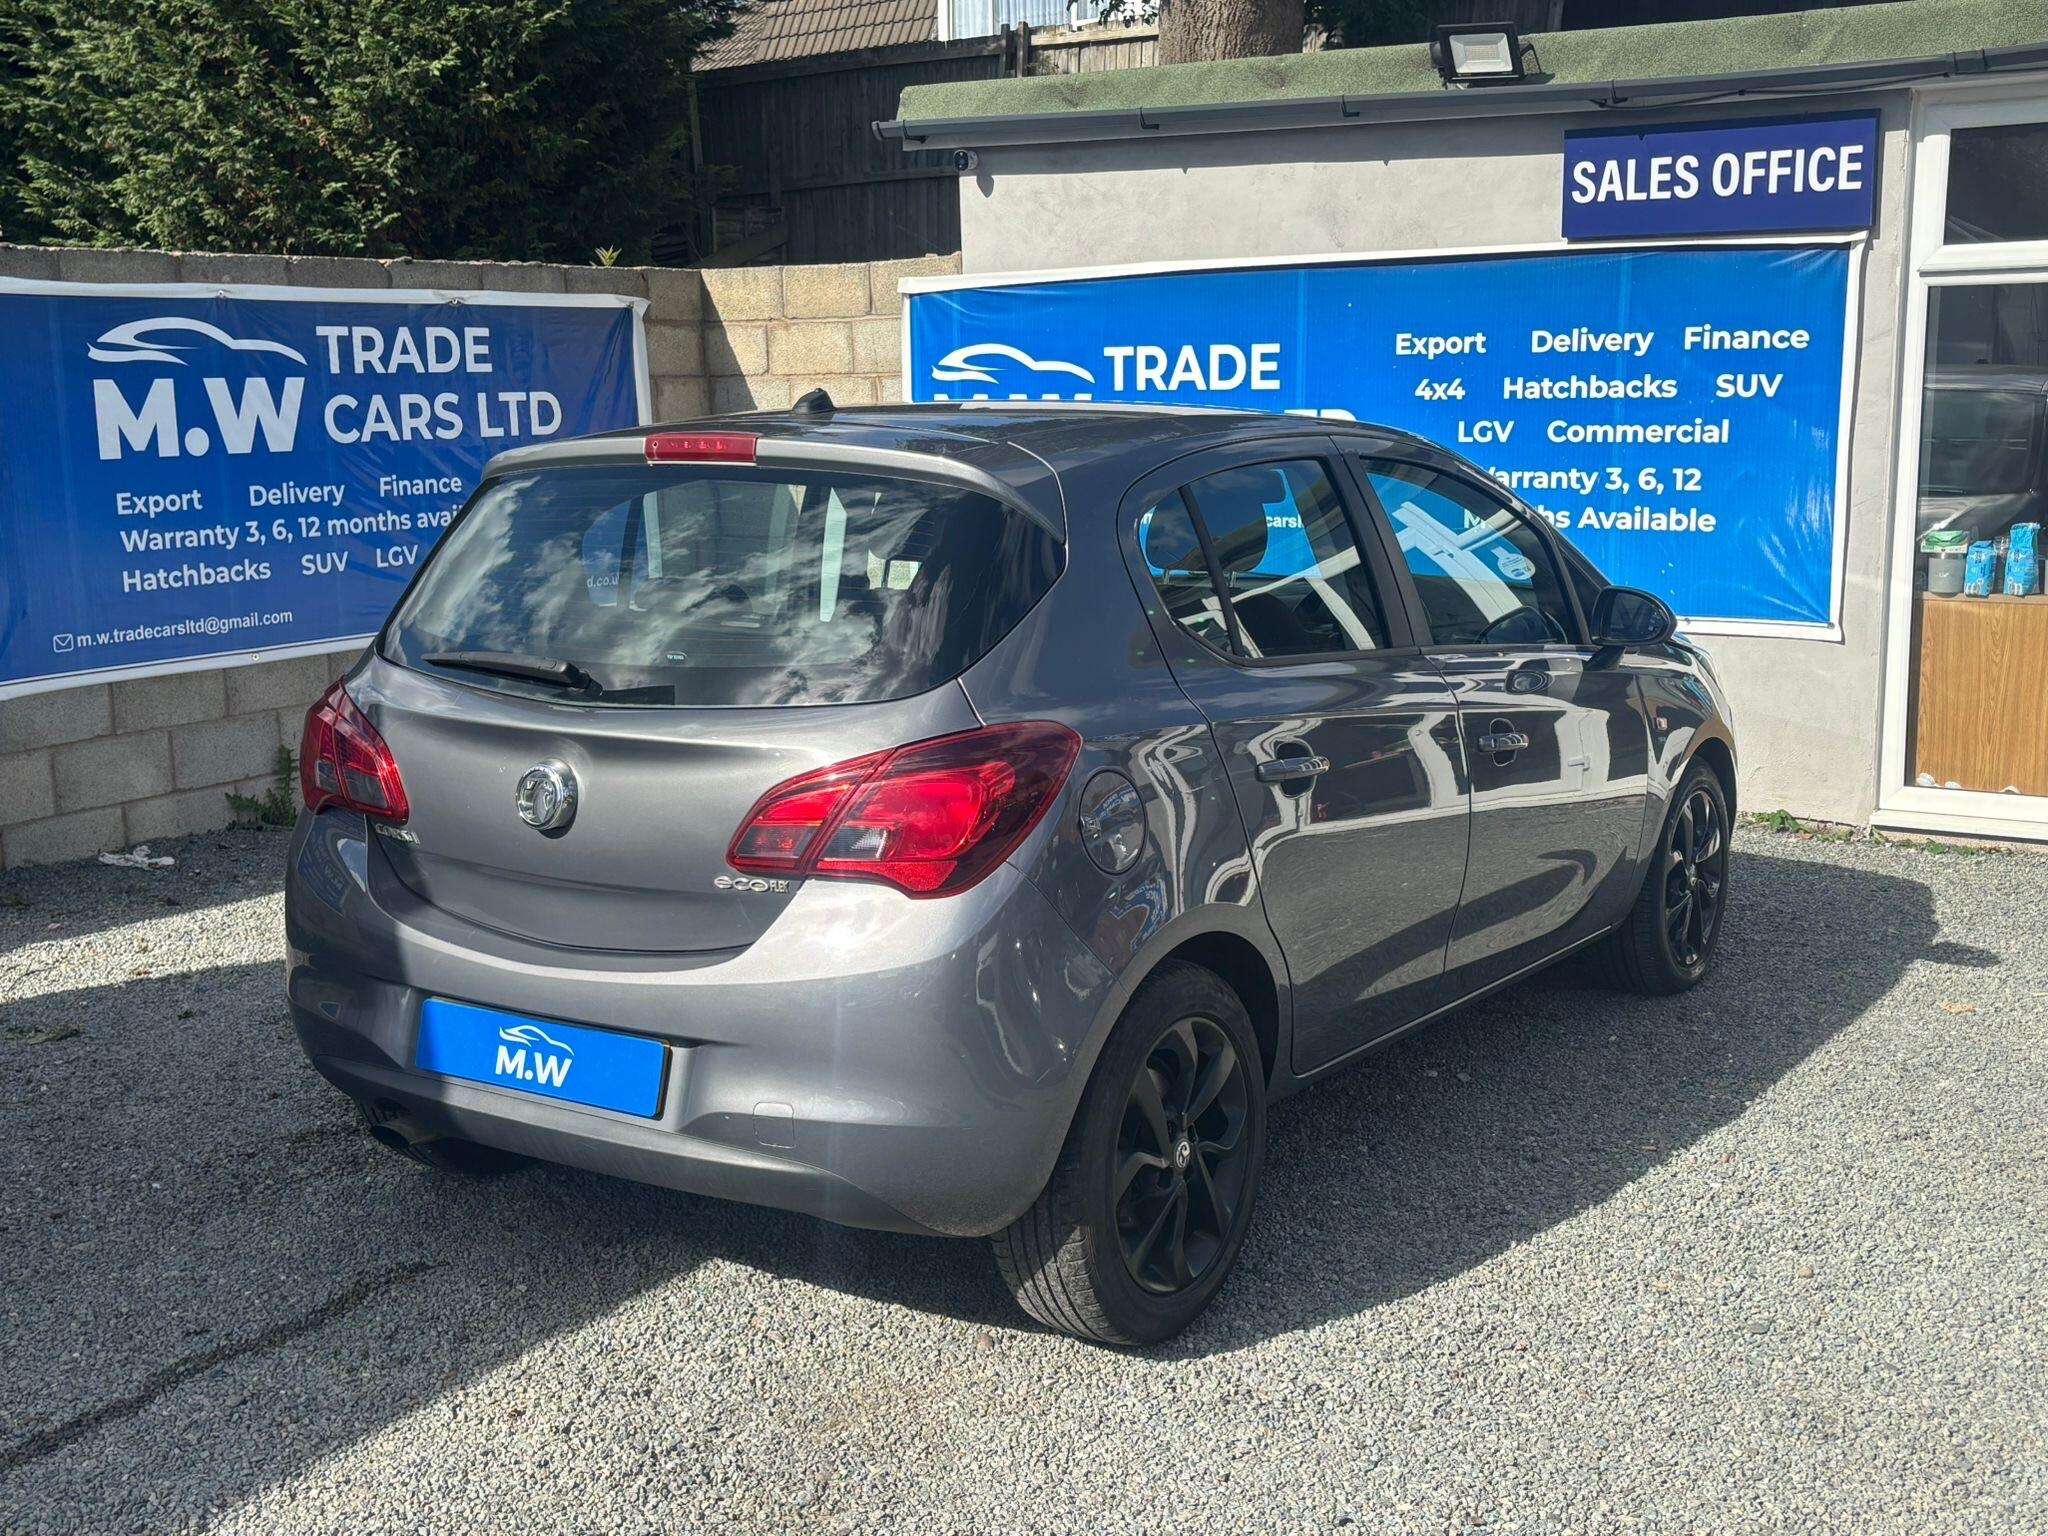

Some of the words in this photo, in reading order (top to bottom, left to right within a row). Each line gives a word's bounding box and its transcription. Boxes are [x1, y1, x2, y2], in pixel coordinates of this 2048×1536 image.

[1572, 156, 1698, 203] SALES
[1713, 145, 1862, 196] OFFICE
[316, 326, 493, 374] TRADE
[1396, 333, 1486, 359] Export
[1532, 327, 1654, 357] Delivery
[1685, 324, 1809, 349] Finance
[1104, 344, 1280, 391] TRADE
[1415, 379, 1465, 400] 4x4
[1504, 374, 1677, 399] Hatchbacks
[1716, 374, 1783, 397] SUV
[93, 377, 305, 460] M.W
[324, 392, 463, 444] CARS
[478, 391, 562, 437] LTD
[1458, 420, 1514, 442] LGV
[1548, 418, 1729, 443] Commercial
[117, 491, 202, 518] Export
[250, 482, 346, 507] Delivery
[380, 475, 462, 497] Finance
[1605, 468, 1629, 494] 3,
[1639, 468, 1664, 494] 6,
[1673, 468, 1701, 491] 12
[120, 524, 239, 553] Warranty
[246, 521, 265, 545] 3,
[273, 519, 293, 543] 6,
[300, 517, 320, 537] 12
[328, 510, 411, 535] months
[1578, 506, 1716, 532] Available
[123, 561, 271, 592] Hatchbacks
[302, 552, 348, 575] SUV
[377, 545, 418, 567] LGV
[78, 612, 293, 648] m.w.tradecarsltd@gmail.com
[495, 1045, 573, 1088] M.W
